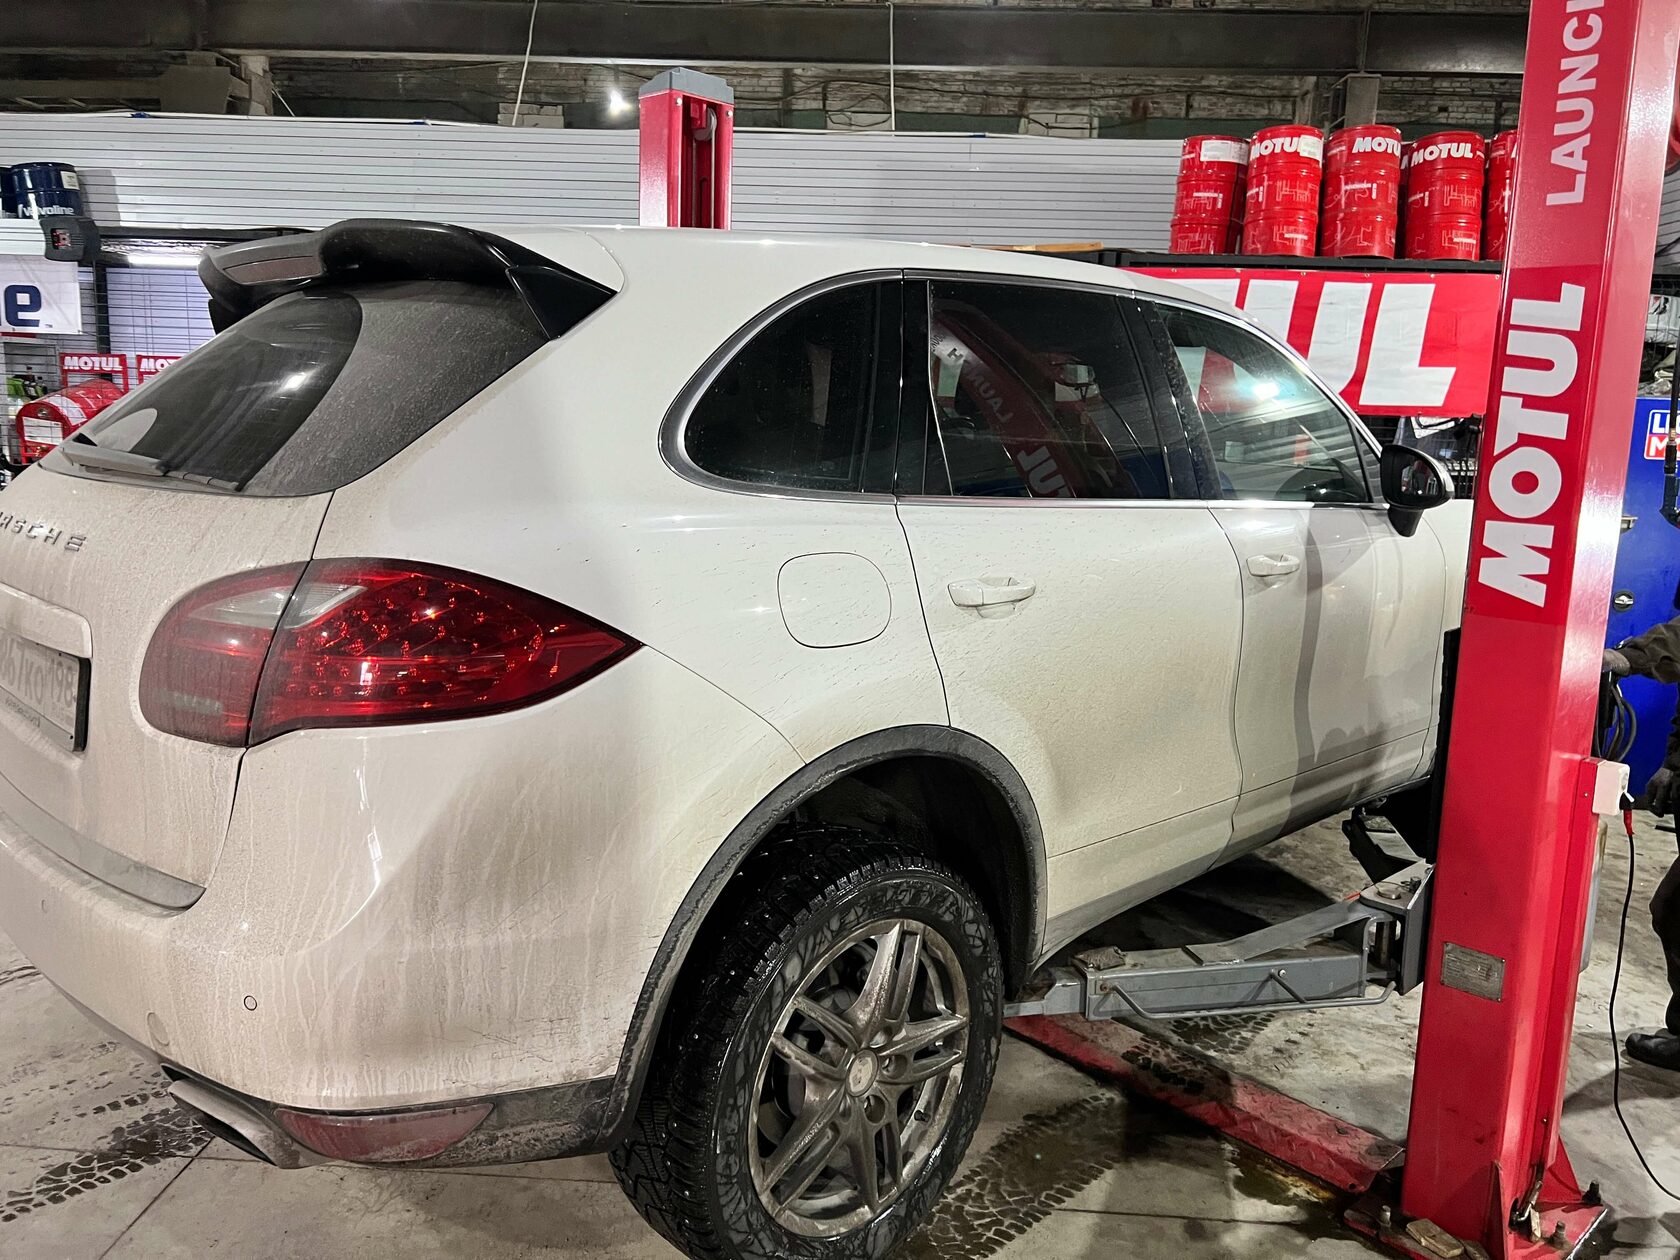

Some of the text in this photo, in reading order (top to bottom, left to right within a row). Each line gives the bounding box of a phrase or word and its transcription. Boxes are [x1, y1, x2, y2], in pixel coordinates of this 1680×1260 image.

[1250, 136, 1301, 161] MOTU
[1411, 143, 1474, 167] MOTUL
[18, 204, 76, 218] Vavoline
[63, 356, 123, 371] MOTUL
[139, 358, 177, 371] MO
[1478, 282, 1585, 608] MOTUL
[50, 658, 73, 708] 198
